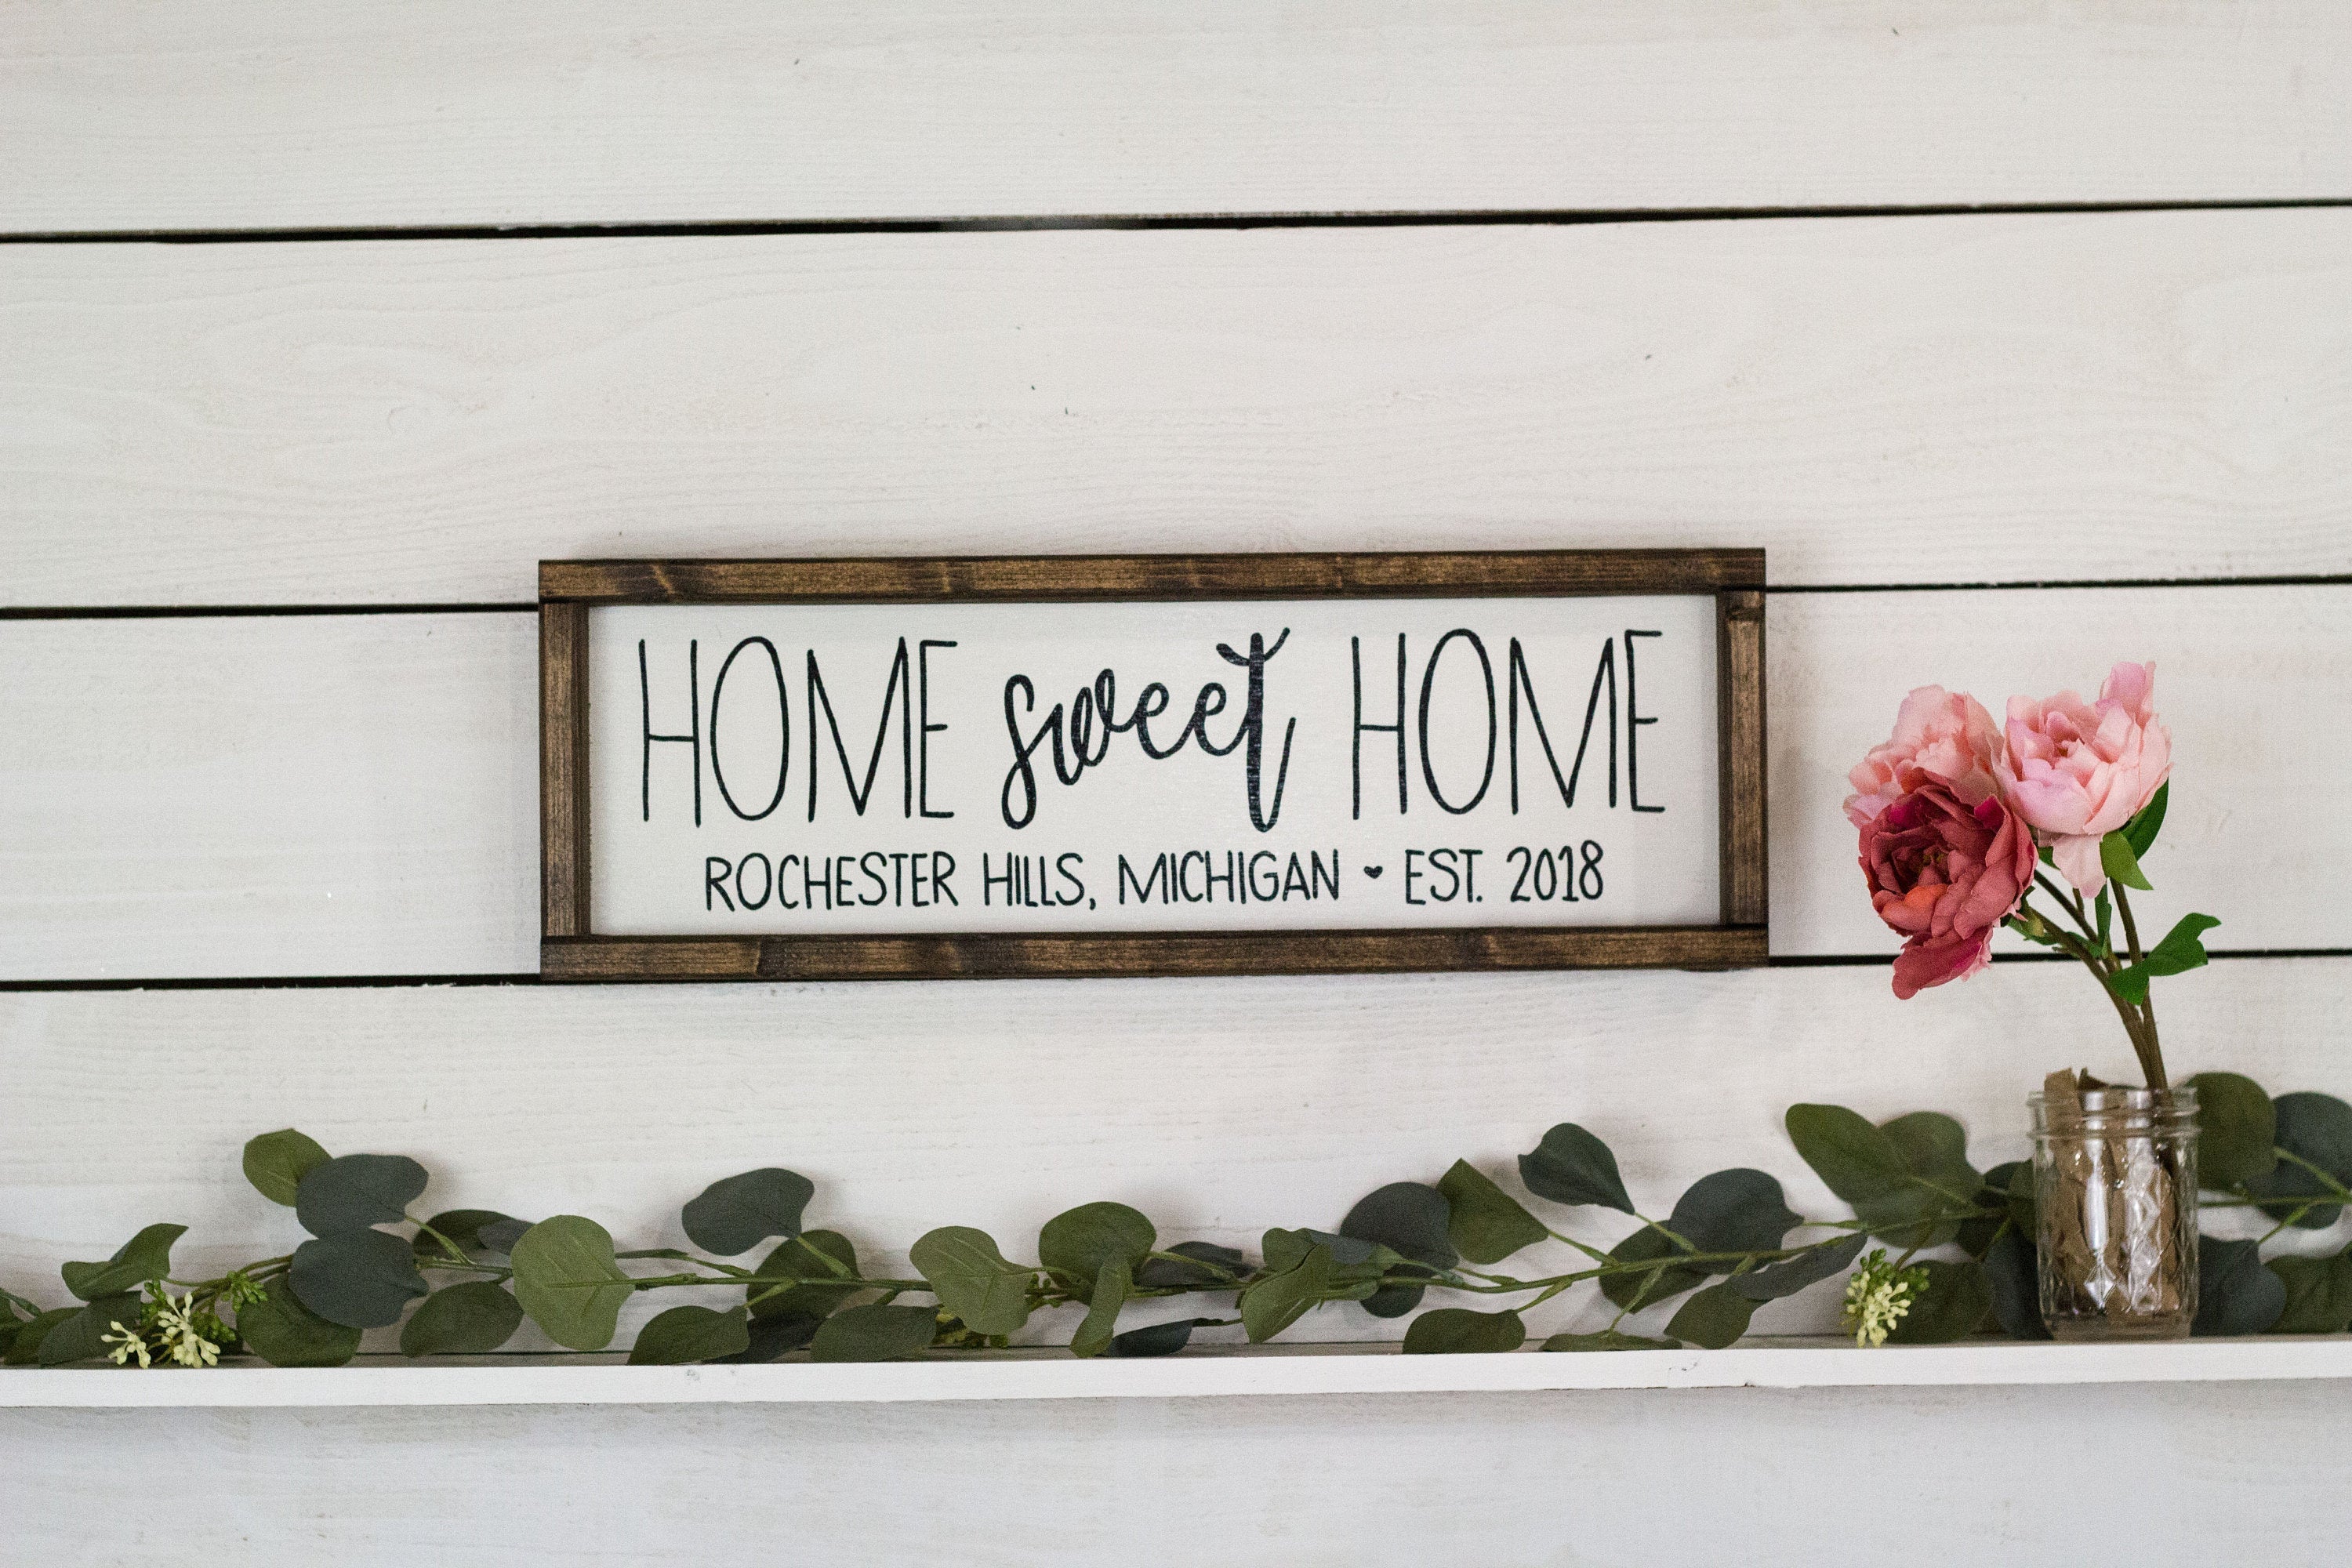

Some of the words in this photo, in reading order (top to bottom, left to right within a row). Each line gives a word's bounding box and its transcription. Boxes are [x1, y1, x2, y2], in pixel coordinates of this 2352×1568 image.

[638, 636, 958, 827] HOME
[1002, 627, 1297, 833] sweet
[1351, 628, 1665, 820] HOME
[705, 851, 959, 912] ROCHESTER
[983, 851, 1096, 911] HILLS,
[1118, 848, 1339, 905] MICHIGAN
[1404, 848, 1483, 906] EST.
[1506, 840, 1604, 902] 2018
